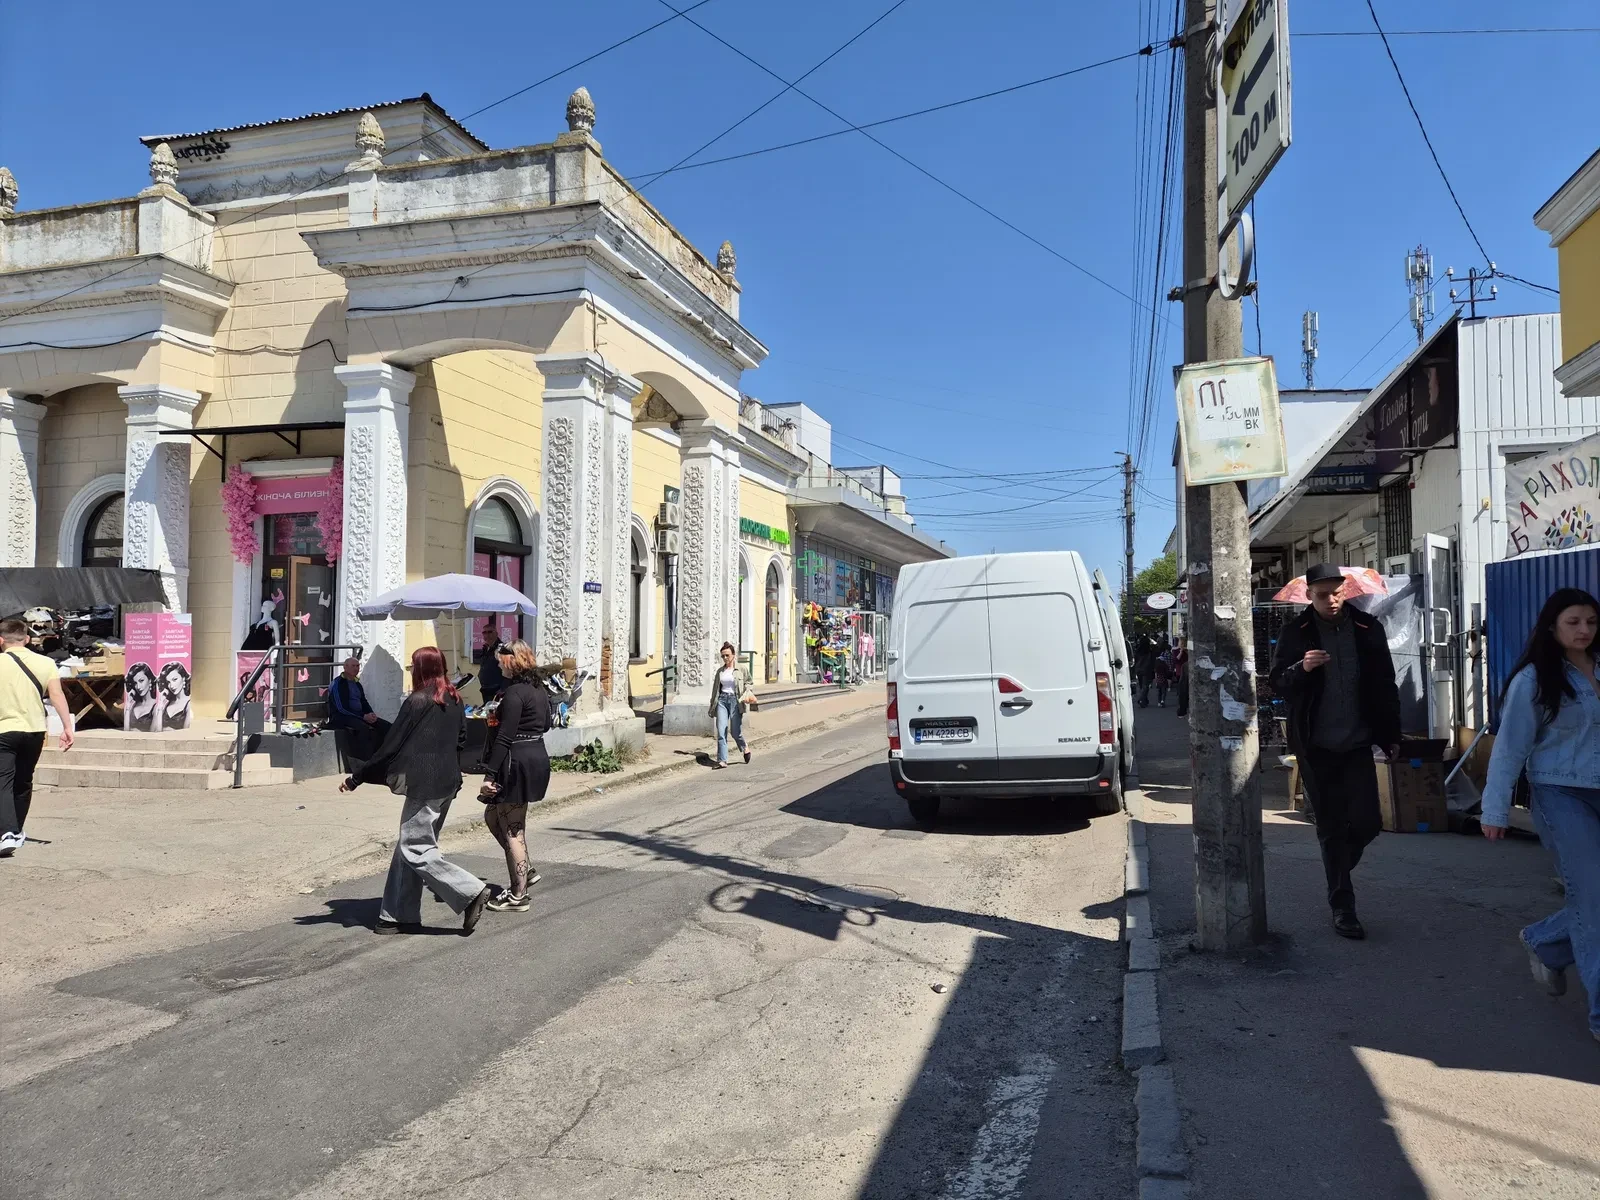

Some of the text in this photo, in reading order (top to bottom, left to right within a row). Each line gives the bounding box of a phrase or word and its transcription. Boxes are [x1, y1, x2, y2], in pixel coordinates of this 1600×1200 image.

[1232, 111, 1260, 176] 100
[255, 490, 330, 501] ЖІНОЧА БІЛИЗН
[1511, 456, 1600, 554] БАРАХОЛ
[922, 729, 934, 739] AM
[936, 728, 955, 739] 4228
[957, 728, 970, 738] CB
